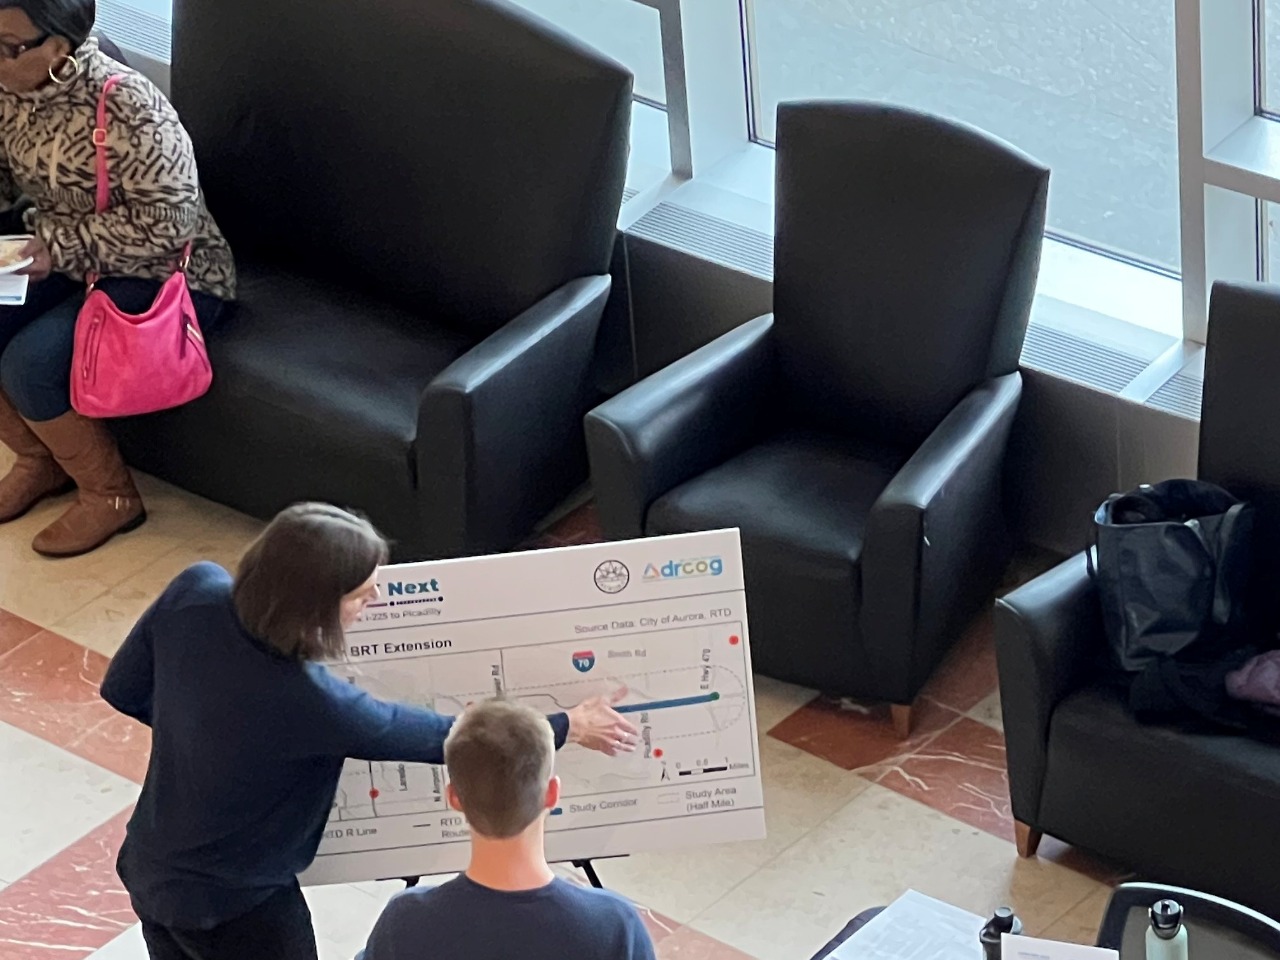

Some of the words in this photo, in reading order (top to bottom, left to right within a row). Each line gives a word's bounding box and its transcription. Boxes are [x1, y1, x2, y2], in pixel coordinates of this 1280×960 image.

[387, 578, 440, 597] Next
[574, 624, 608, 634] Source
[639, 617, 658, 629] City
[661, 615, 671, 624] of
[709, 608, 732, 619] RTD
[350, 643, 379, 657] BRT
[384, 639, 452, 654] Extension
[685, 789, 712, 800] Study
[714, 786, 737, 796] Area
[569, 802, 597, 814] Study
[686, 801, 710, 812] (Half
[711, 799, 735, 810] Mile)
[346, 829, 354, 837] R
[357, 828, 377, 837] Line
